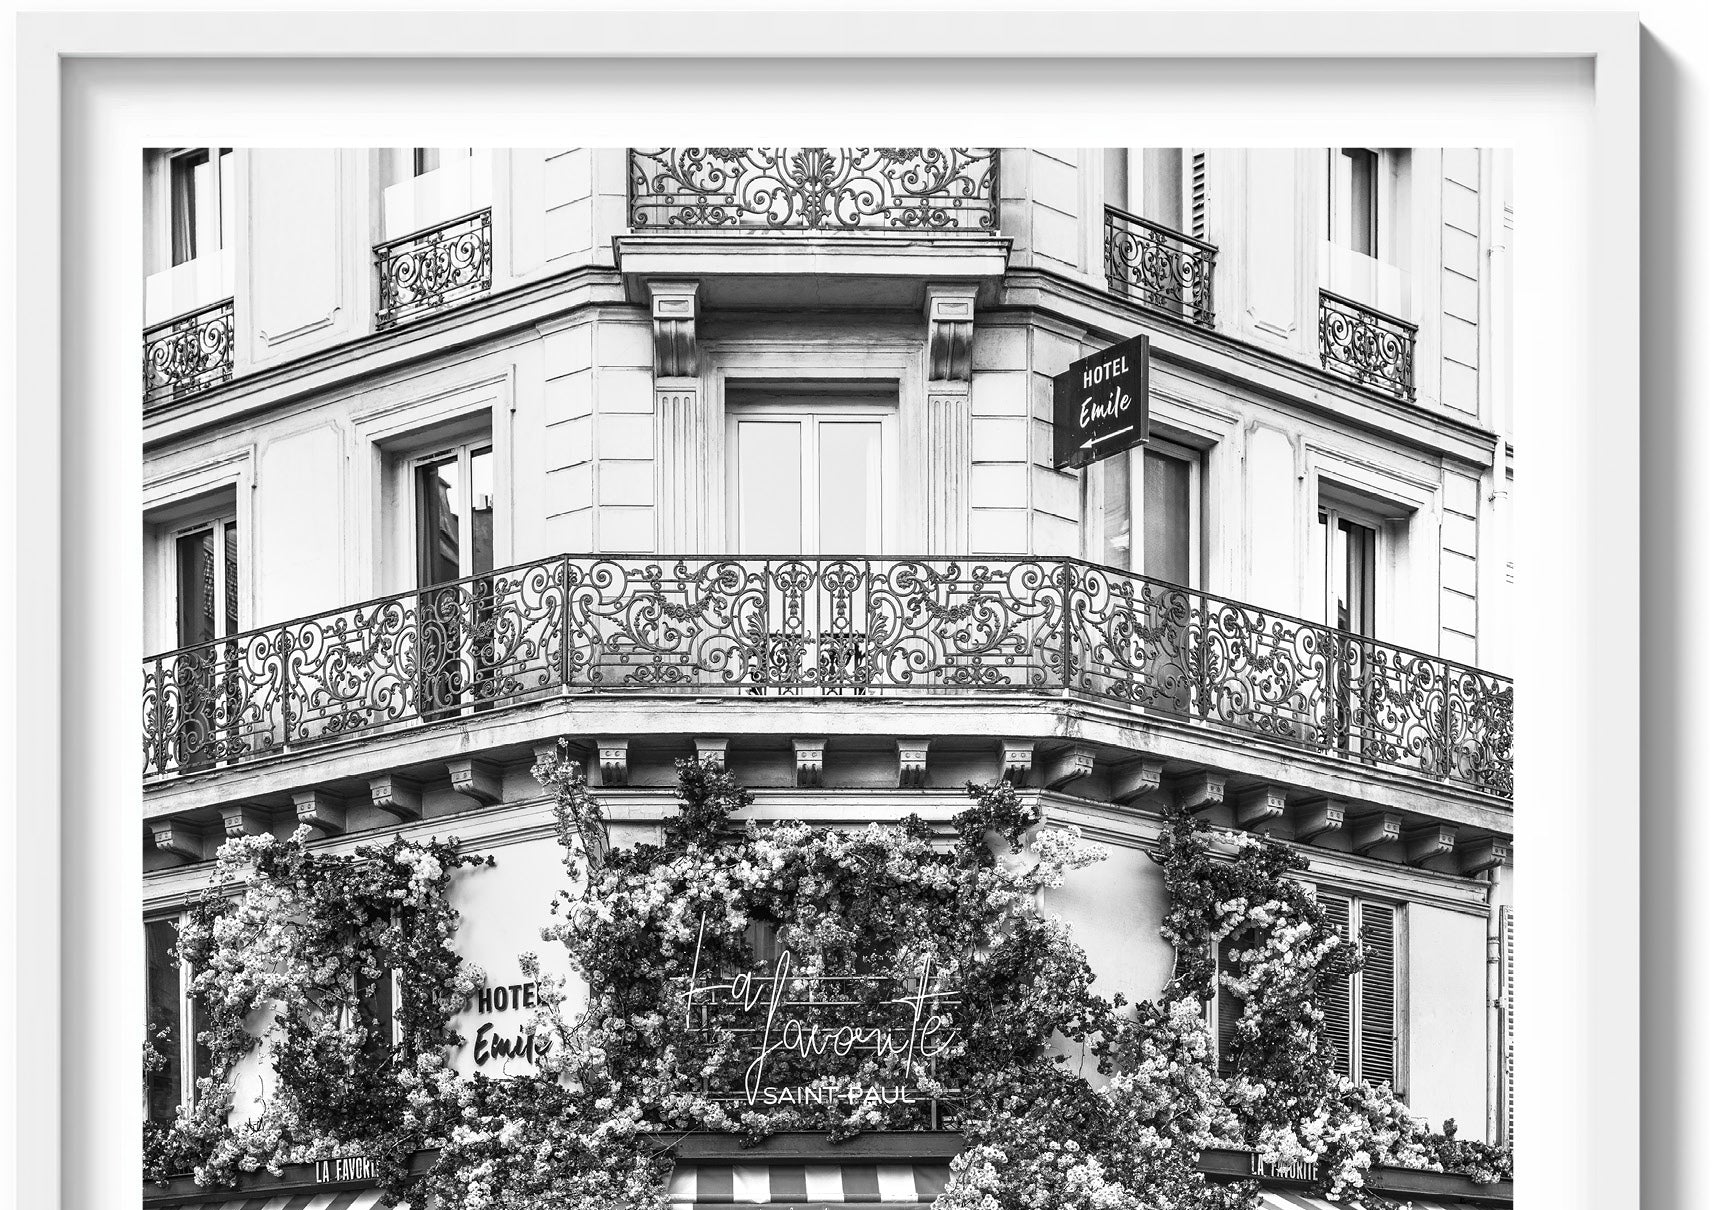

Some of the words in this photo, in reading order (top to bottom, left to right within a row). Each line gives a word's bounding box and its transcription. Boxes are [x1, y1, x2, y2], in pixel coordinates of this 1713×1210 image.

[1083, 356, 1129, 389] HOTEL
[1079, 386, 1132, 428] Emile
[763, 1086, 916, 1105] SAINT-PAUL
[316, 1160, 330, 1183] LA
[336, 1157, 379, 1181] FAVORI
[1251, 1153, 1264, 1176] LA
